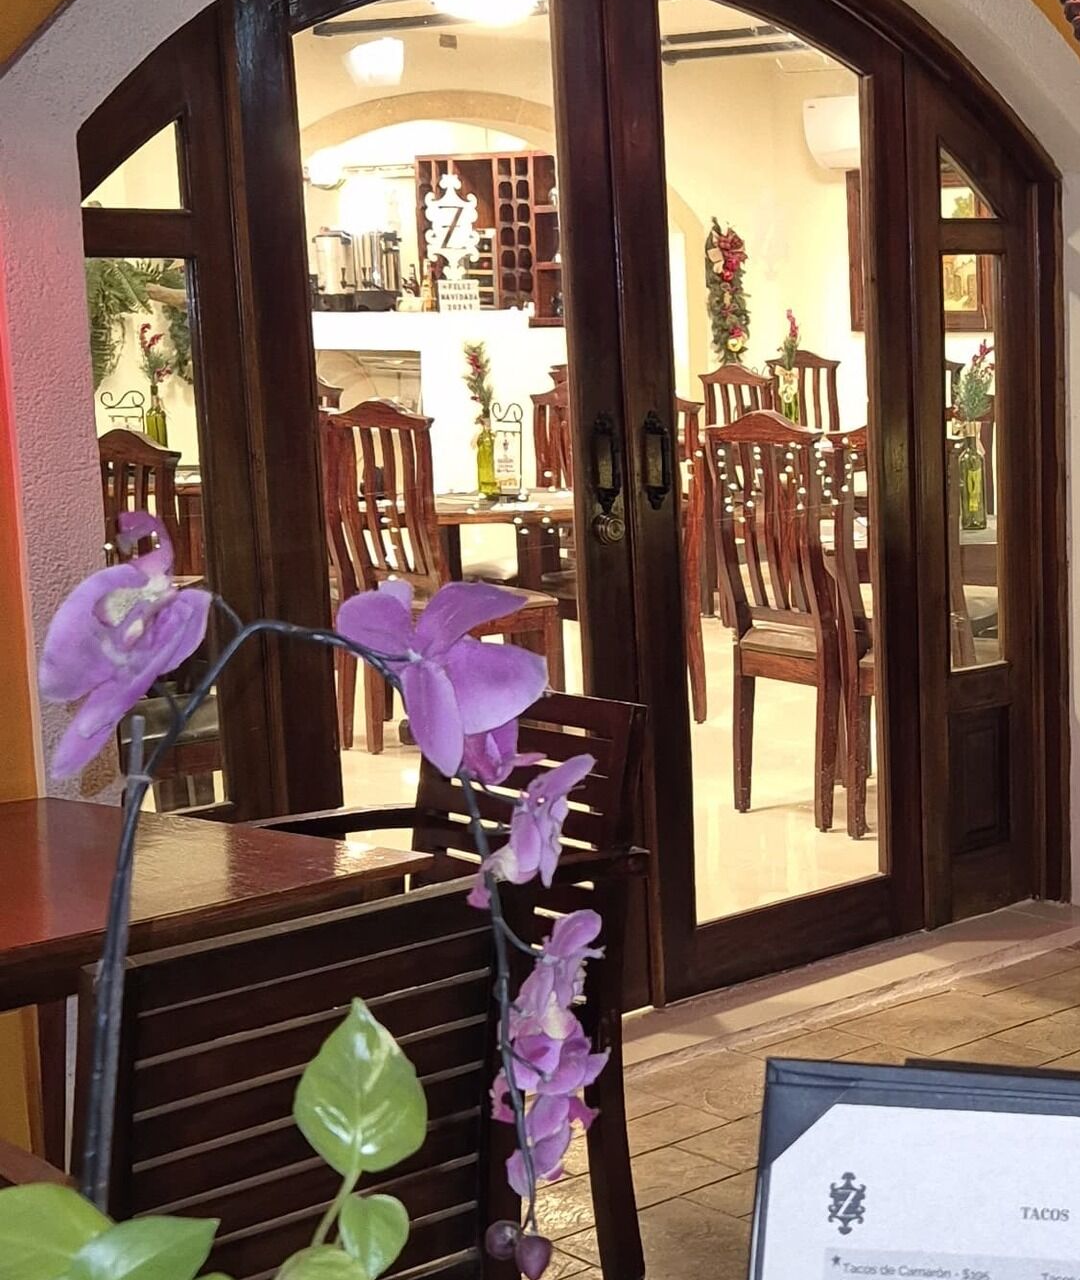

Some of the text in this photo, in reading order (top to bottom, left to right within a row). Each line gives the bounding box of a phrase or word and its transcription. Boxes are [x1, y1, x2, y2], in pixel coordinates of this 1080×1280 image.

[1020, 1206, 1070, 1221] TACOS
[843, 1262, 877, 1275] Tacos
[879, 1264, 896, 1275] de
